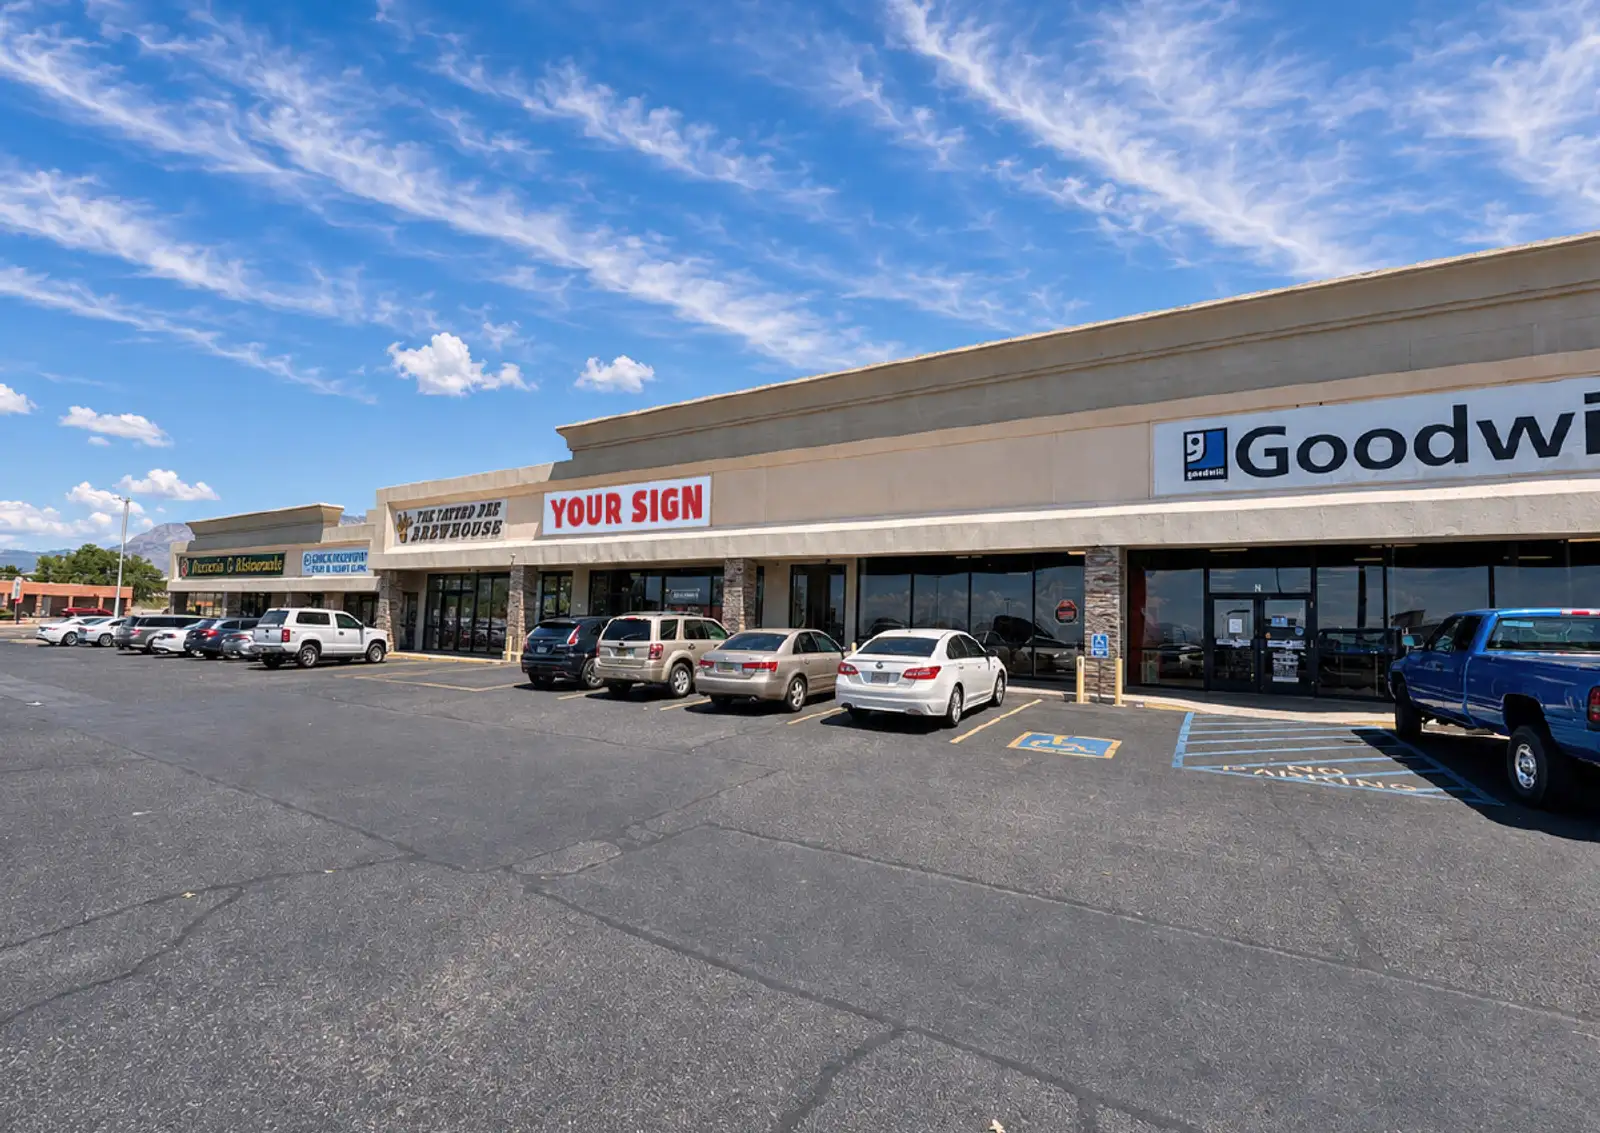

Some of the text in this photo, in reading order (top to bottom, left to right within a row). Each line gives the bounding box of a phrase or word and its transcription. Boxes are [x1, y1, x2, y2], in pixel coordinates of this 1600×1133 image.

[1235, 393, 1600, 478] Goodwi
[416, 509, 436, 524] THE
[550, 484, 703, 529] YOUR SIGN
[411, 520, 502, 542] BREWHOUSE
[1286, 764, 1344, 777] NO
